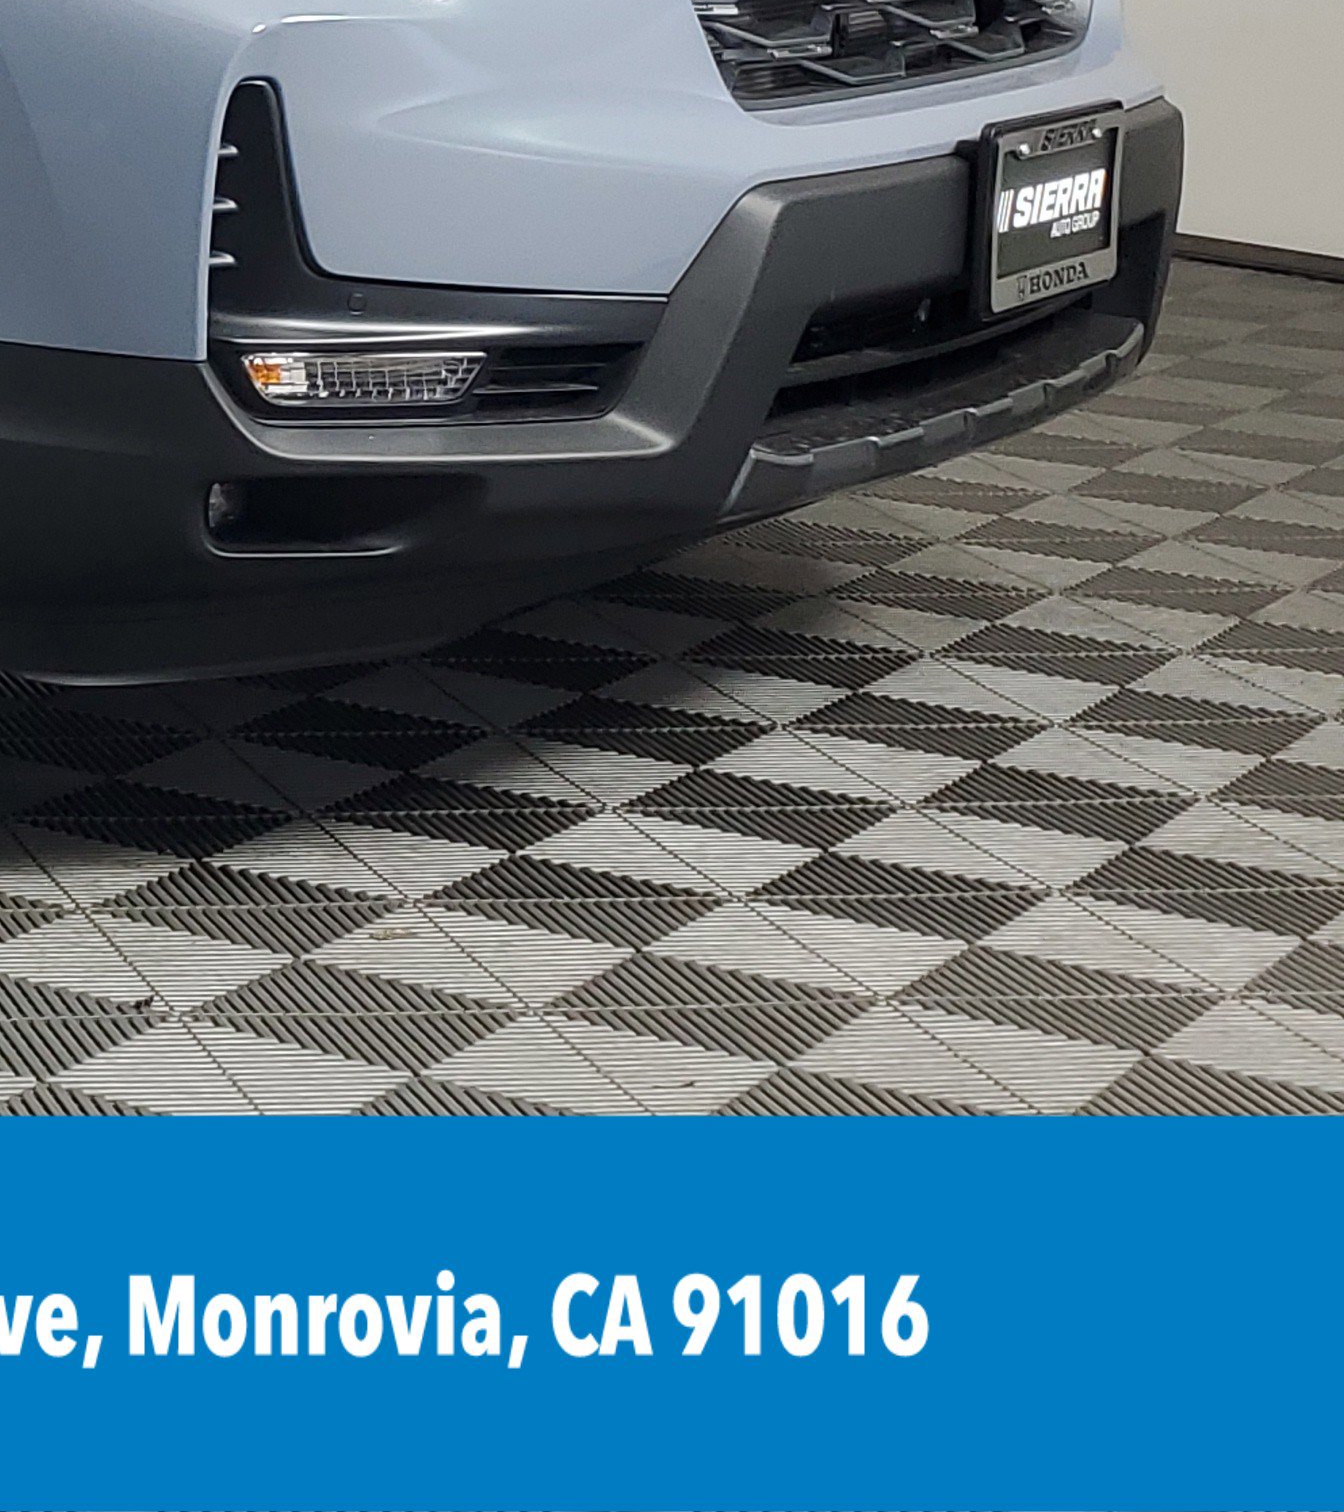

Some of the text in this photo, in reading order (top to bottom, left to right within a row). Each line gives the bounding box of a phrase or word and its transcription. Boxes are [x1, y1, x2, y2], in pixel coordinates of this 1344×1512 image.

[1013, 168, 1106, 227] SIERRA
[1072, 210, 1100, 233] GROUP
[1029, 261, 1089, 294] HONDA
